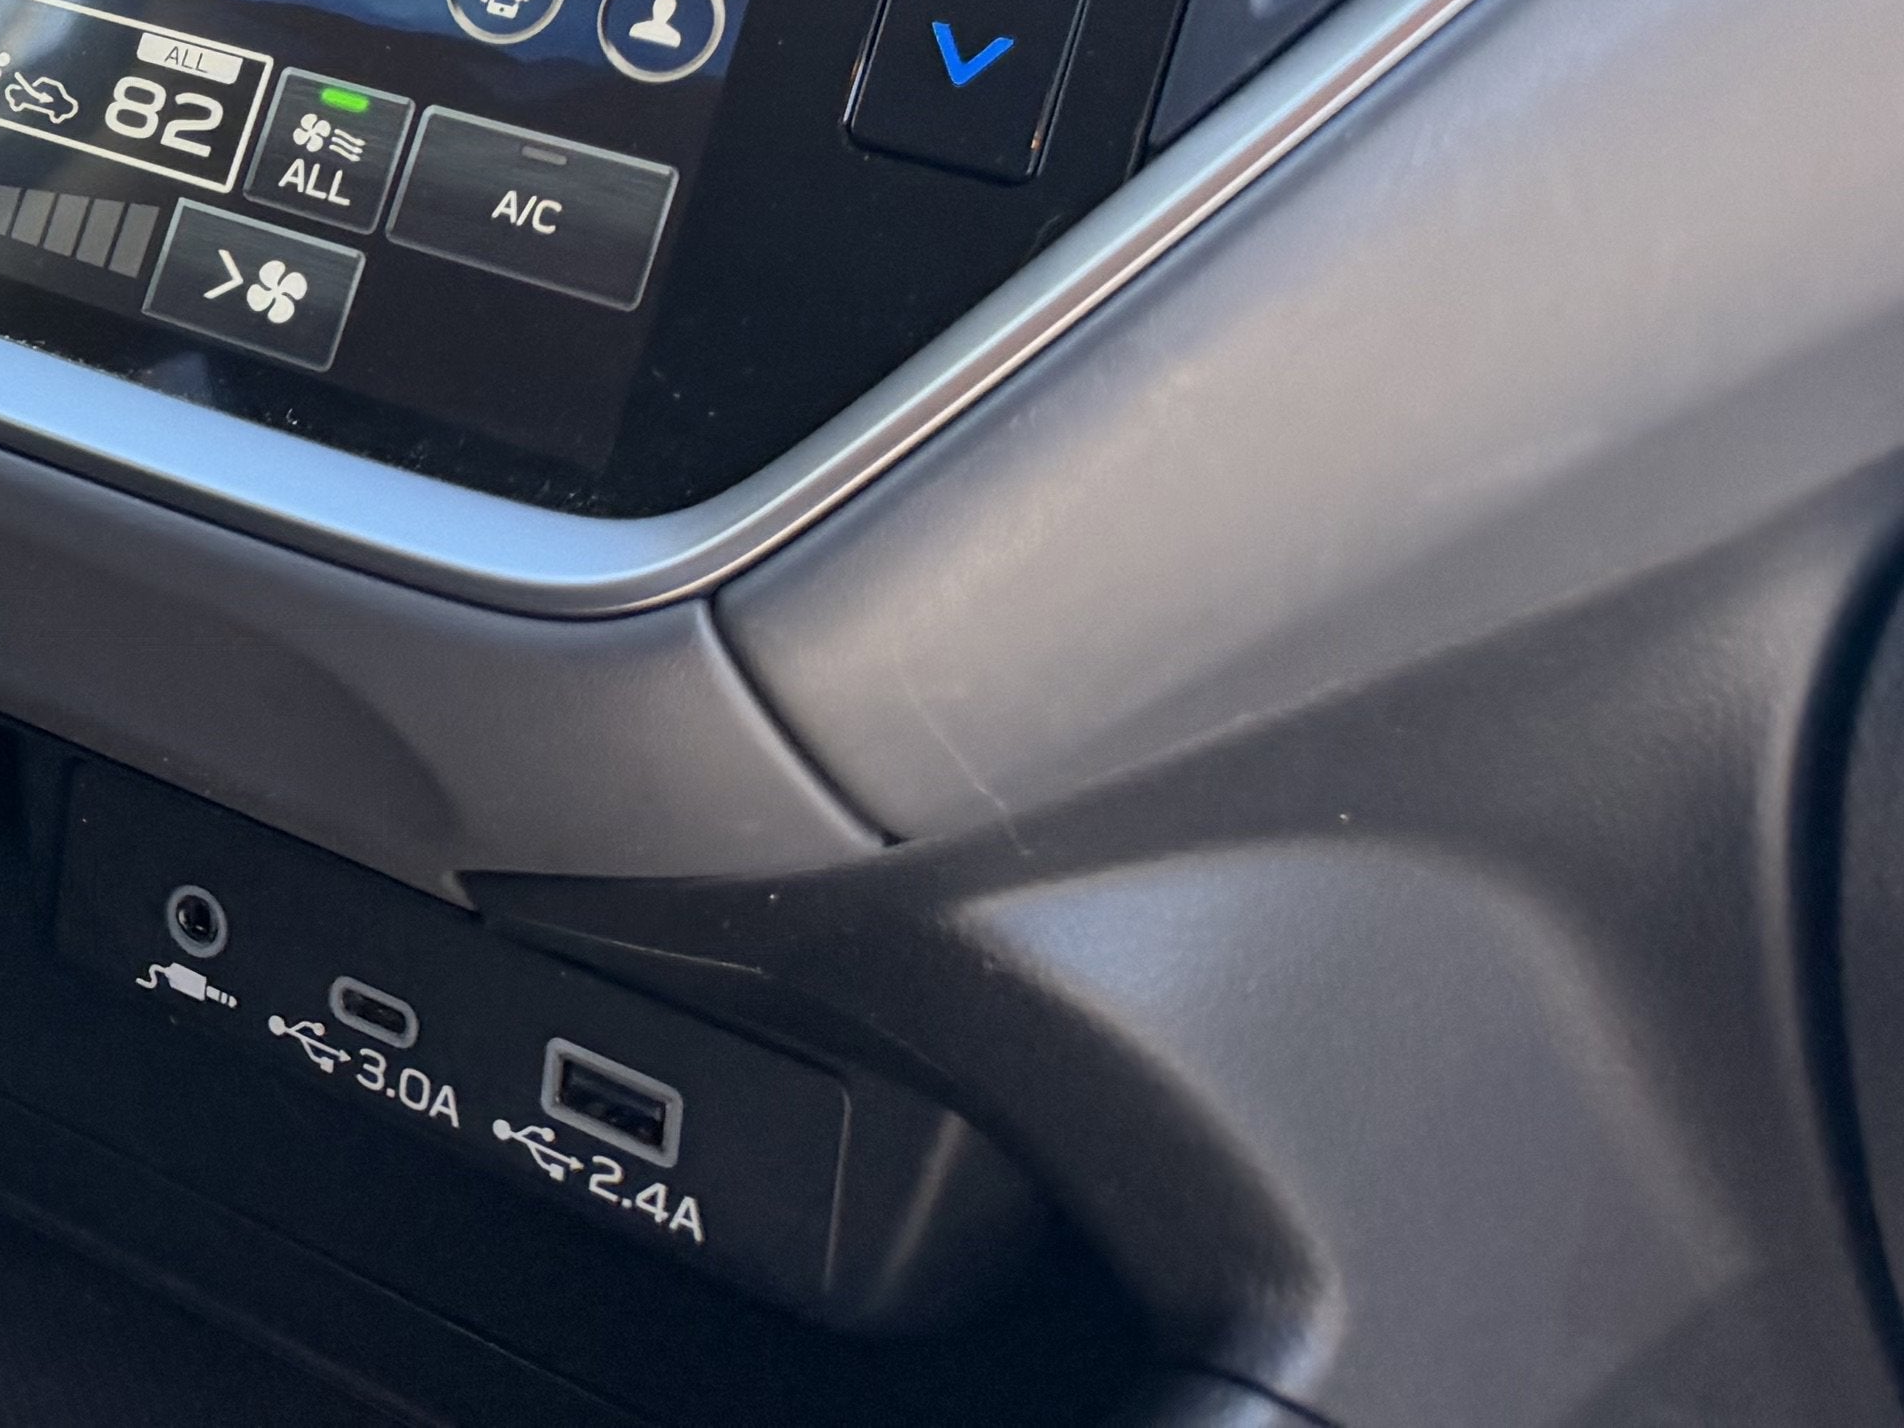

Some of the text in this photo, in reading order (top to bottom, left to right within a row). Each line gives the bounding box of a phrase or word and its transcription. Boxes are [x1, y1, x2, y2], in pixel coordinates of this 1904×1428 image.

[163, 45, 211, 74] ALL
[103, 75, 225, 159] 82
[278, 157, 352, 207] ALL
[491, 188, 564, 235] A/C
[354, 1046, 461, 1129] 3.0A
[587, 1154, 706, 1243] 2.4A
